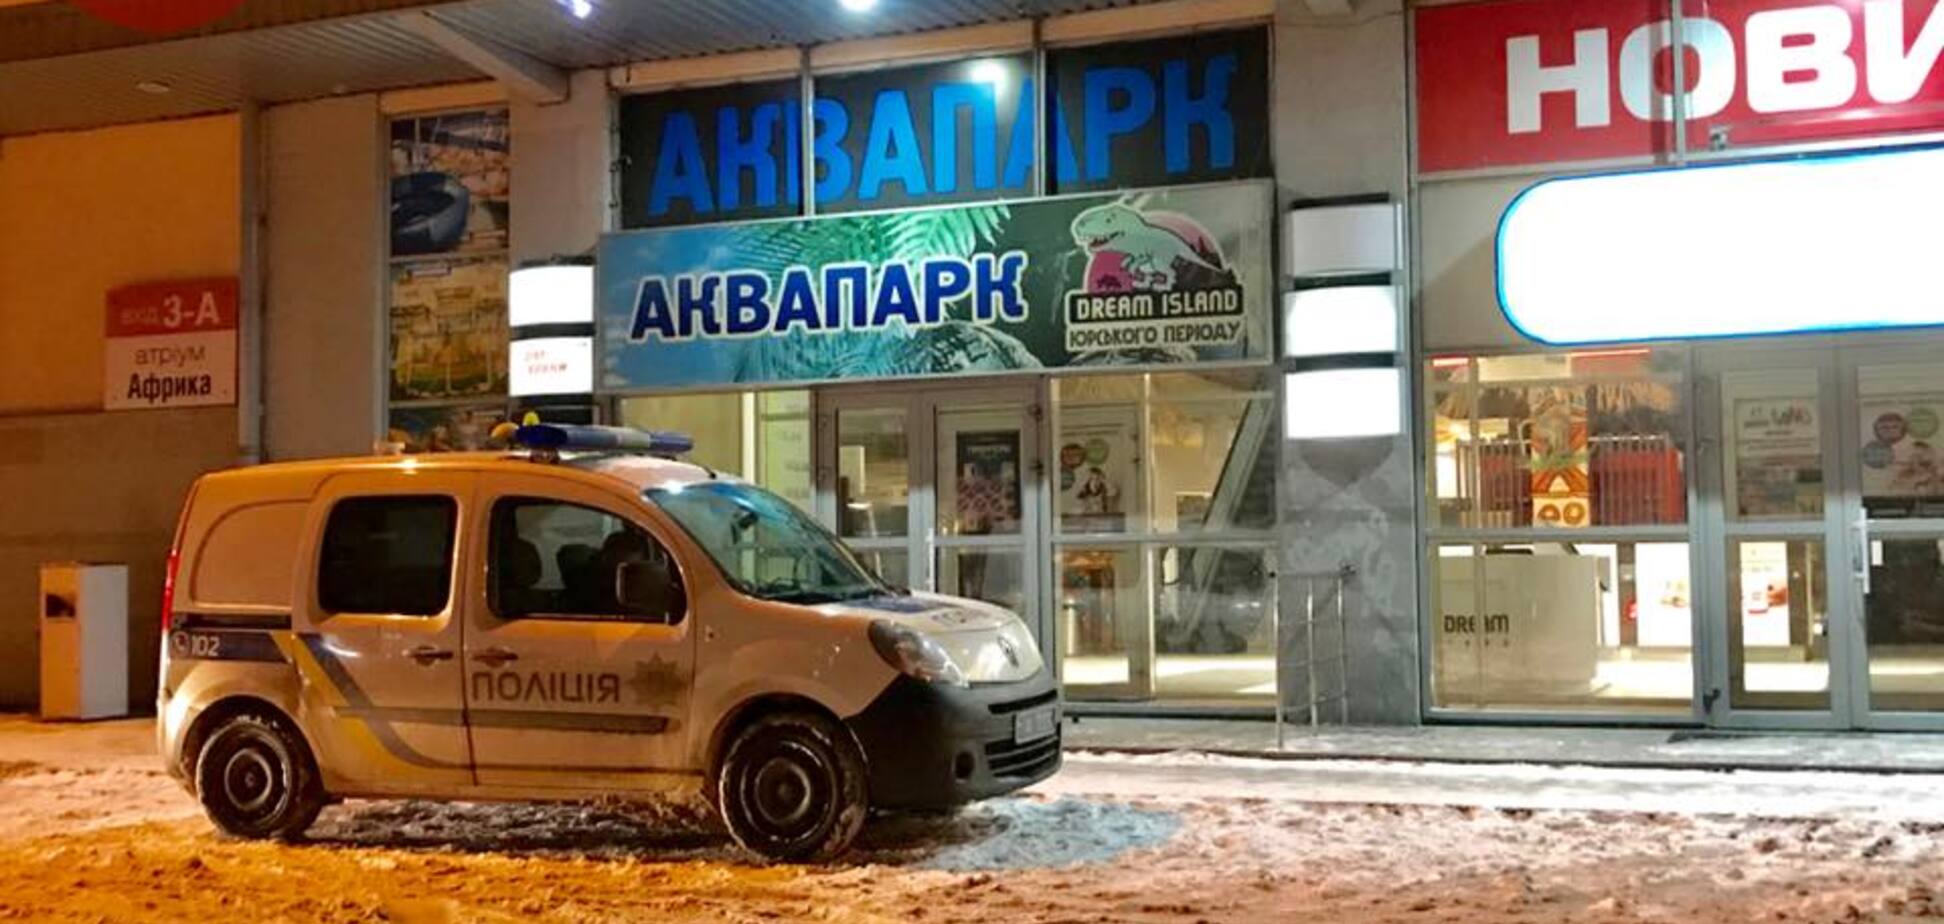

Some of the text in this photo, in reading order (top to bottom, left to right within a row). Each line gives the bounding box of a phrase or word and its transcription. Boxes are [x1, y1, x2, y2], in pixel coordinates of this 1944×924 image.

[647, 54, 1239, 217] АКВАПАРК
[630, 253, 1027, 340] АКВАПАРК
[1076, 288, 1238, 320] DREAM ISLAND
[1069, 321, 1241, 348] ЮРСЬКОГО ПЕРІОДУ
[133, 344, 206, 367] атріум
[127, 372, 212, 404] Африка
[191, 635, 220, 657] 102
[471, 671, 620, 703] ПОЛІЦІЯ
